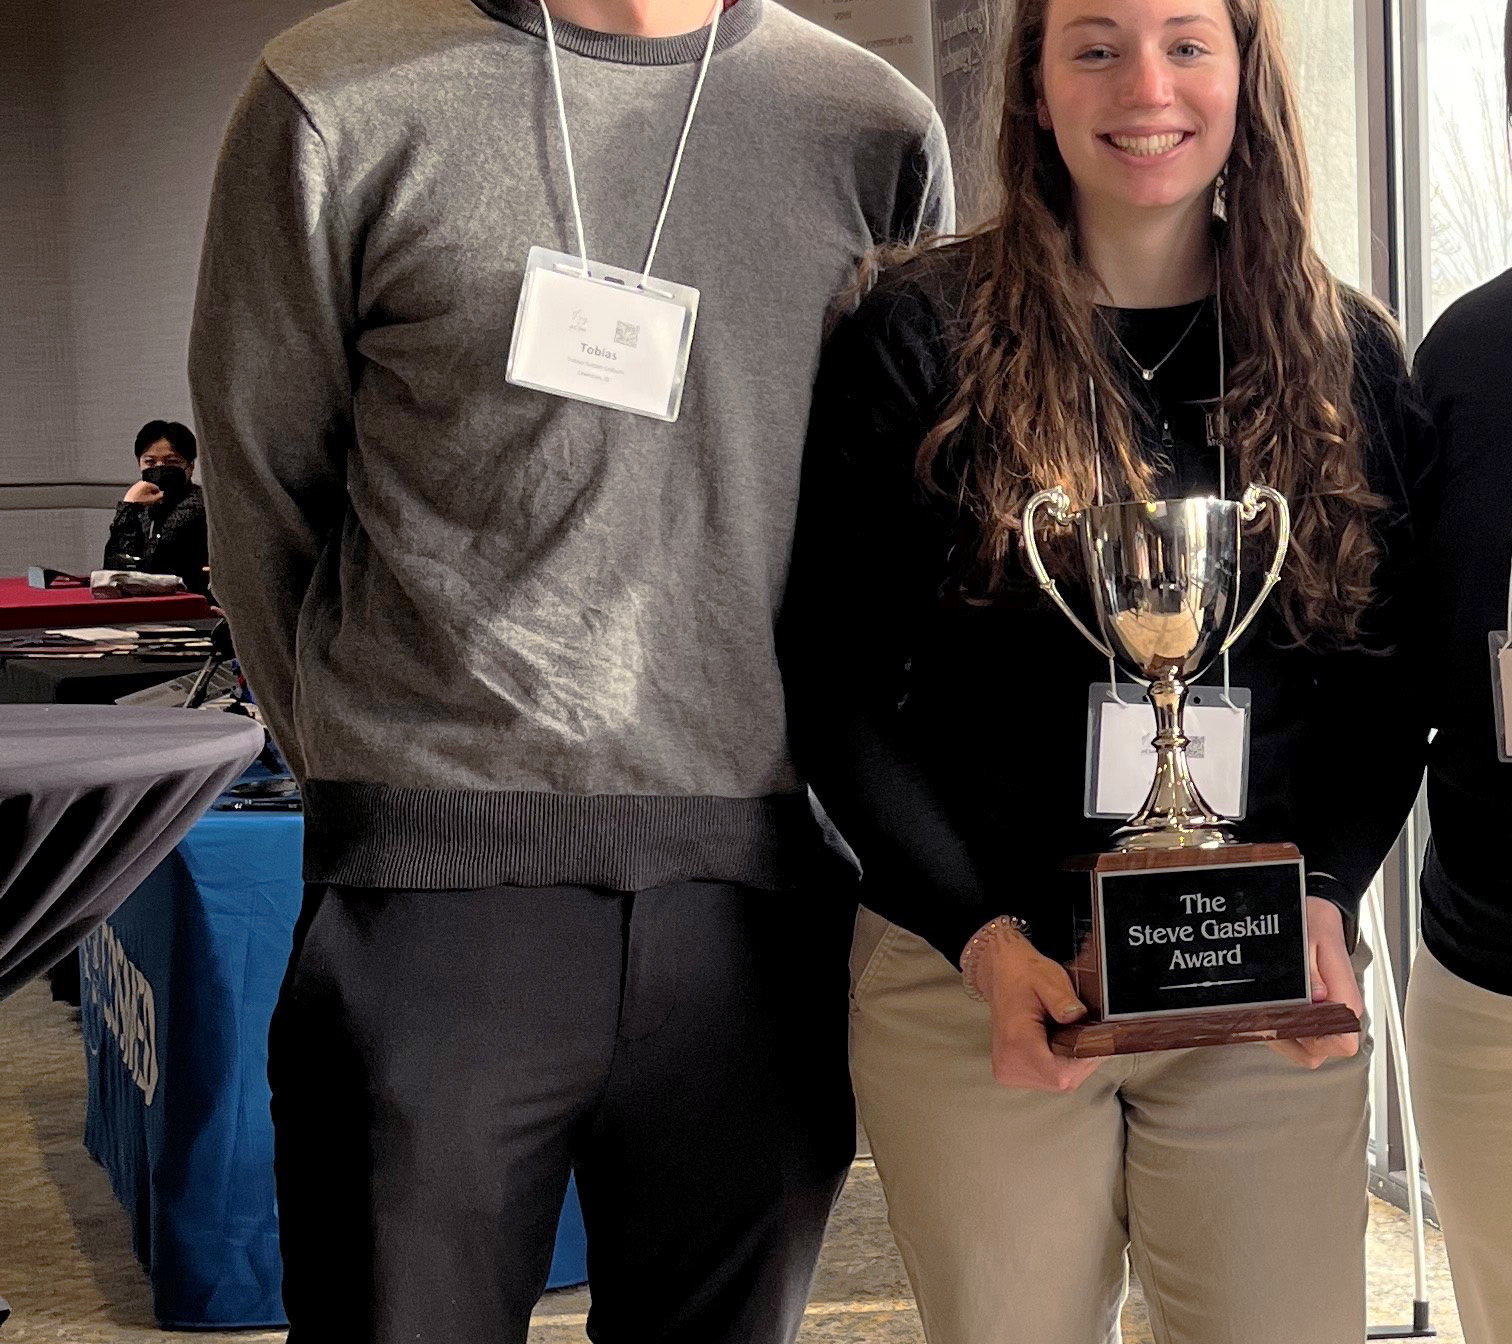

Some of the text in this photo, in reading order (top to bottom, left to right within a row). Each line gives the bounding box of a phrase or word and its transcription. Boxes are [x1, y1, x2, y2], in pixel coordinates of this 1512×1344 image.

[581, 342, 617, 361] Tobias
[1180, 893, 1227, 915] The
[1128, 914, 1280, 946] Steve Gaskill
[1168, 943, 1242, 971] Award
